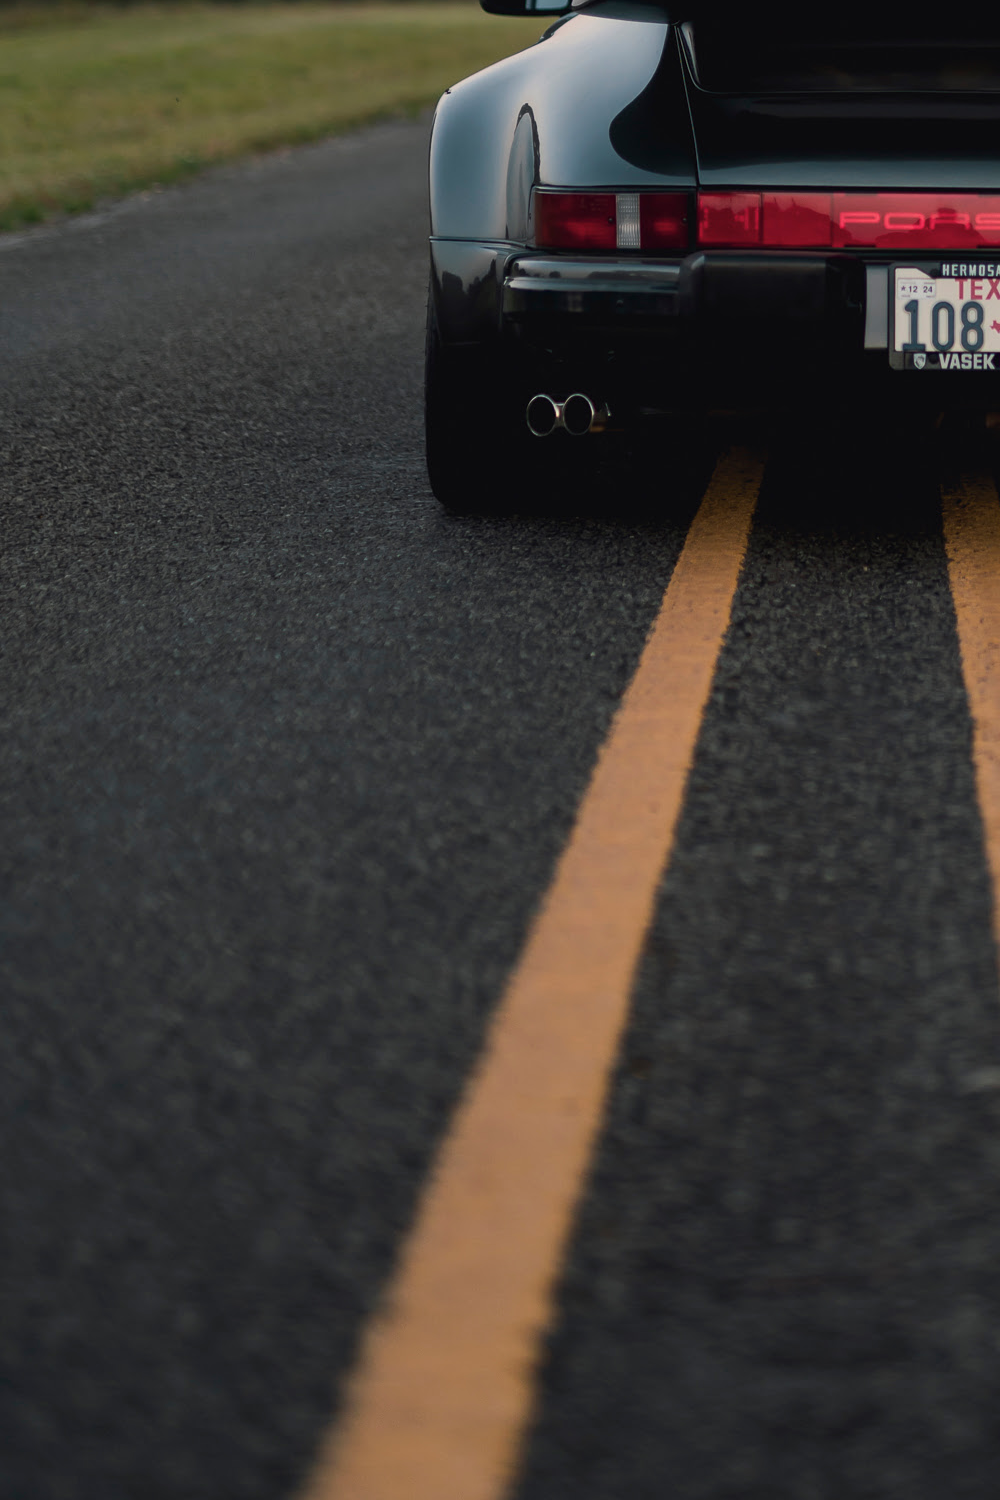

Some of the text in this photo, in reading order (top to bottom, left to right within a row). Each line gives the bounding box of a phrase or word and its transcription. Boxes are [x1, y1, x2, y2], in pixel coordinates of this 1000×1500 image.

[908, 285, 933, 294] 12 24
[902, 300, 984, 352] 108
[938, 353, 995, 370] VASEK
